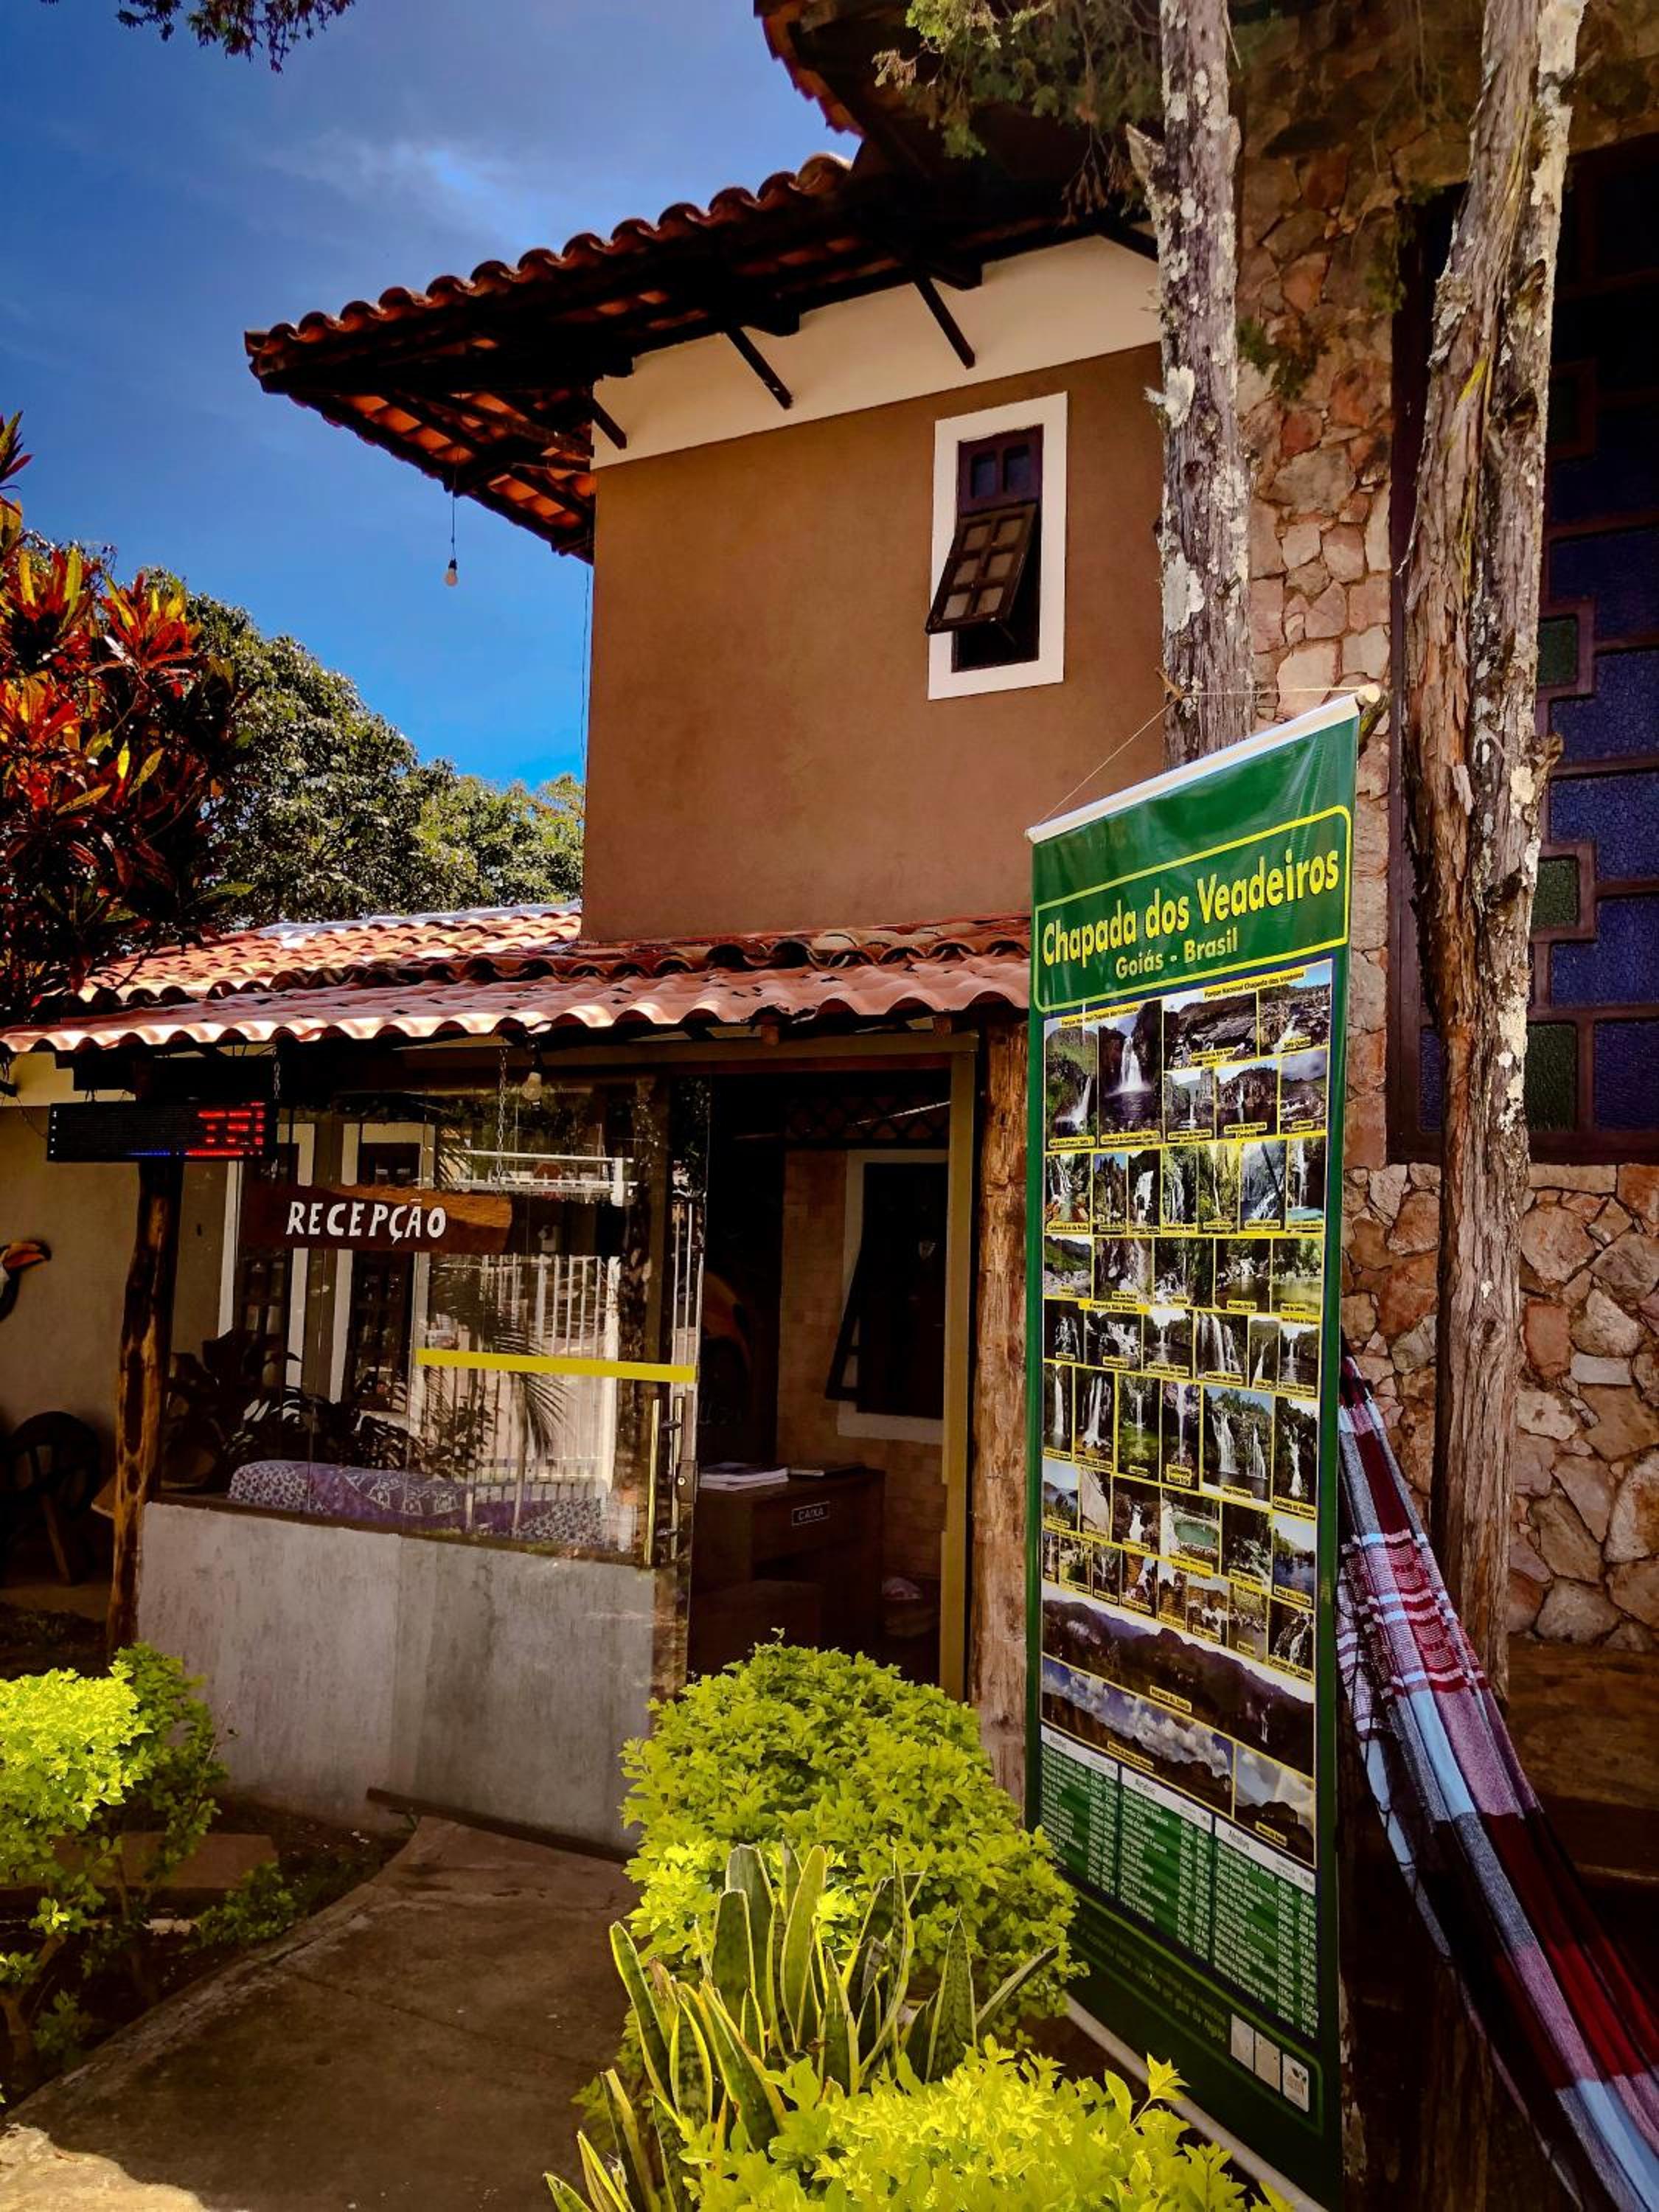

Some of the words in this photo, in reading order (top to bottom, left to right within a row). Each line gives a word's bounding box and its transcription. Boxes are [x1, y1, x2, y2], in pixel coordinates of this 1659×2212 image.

[1043, 900, 1136, 967] Chapada
[1145, 888, 1189, 939] dos
[1197, 849, 1338, 924] Veadeiros
[1116, 950, 1164, 979] Goiás
[1184, 927, 1237, 963] Brasil
[285, 1198, 447, 1245] RECEPÇÃO
[799, 1508, 824, 1521] CAIXA
